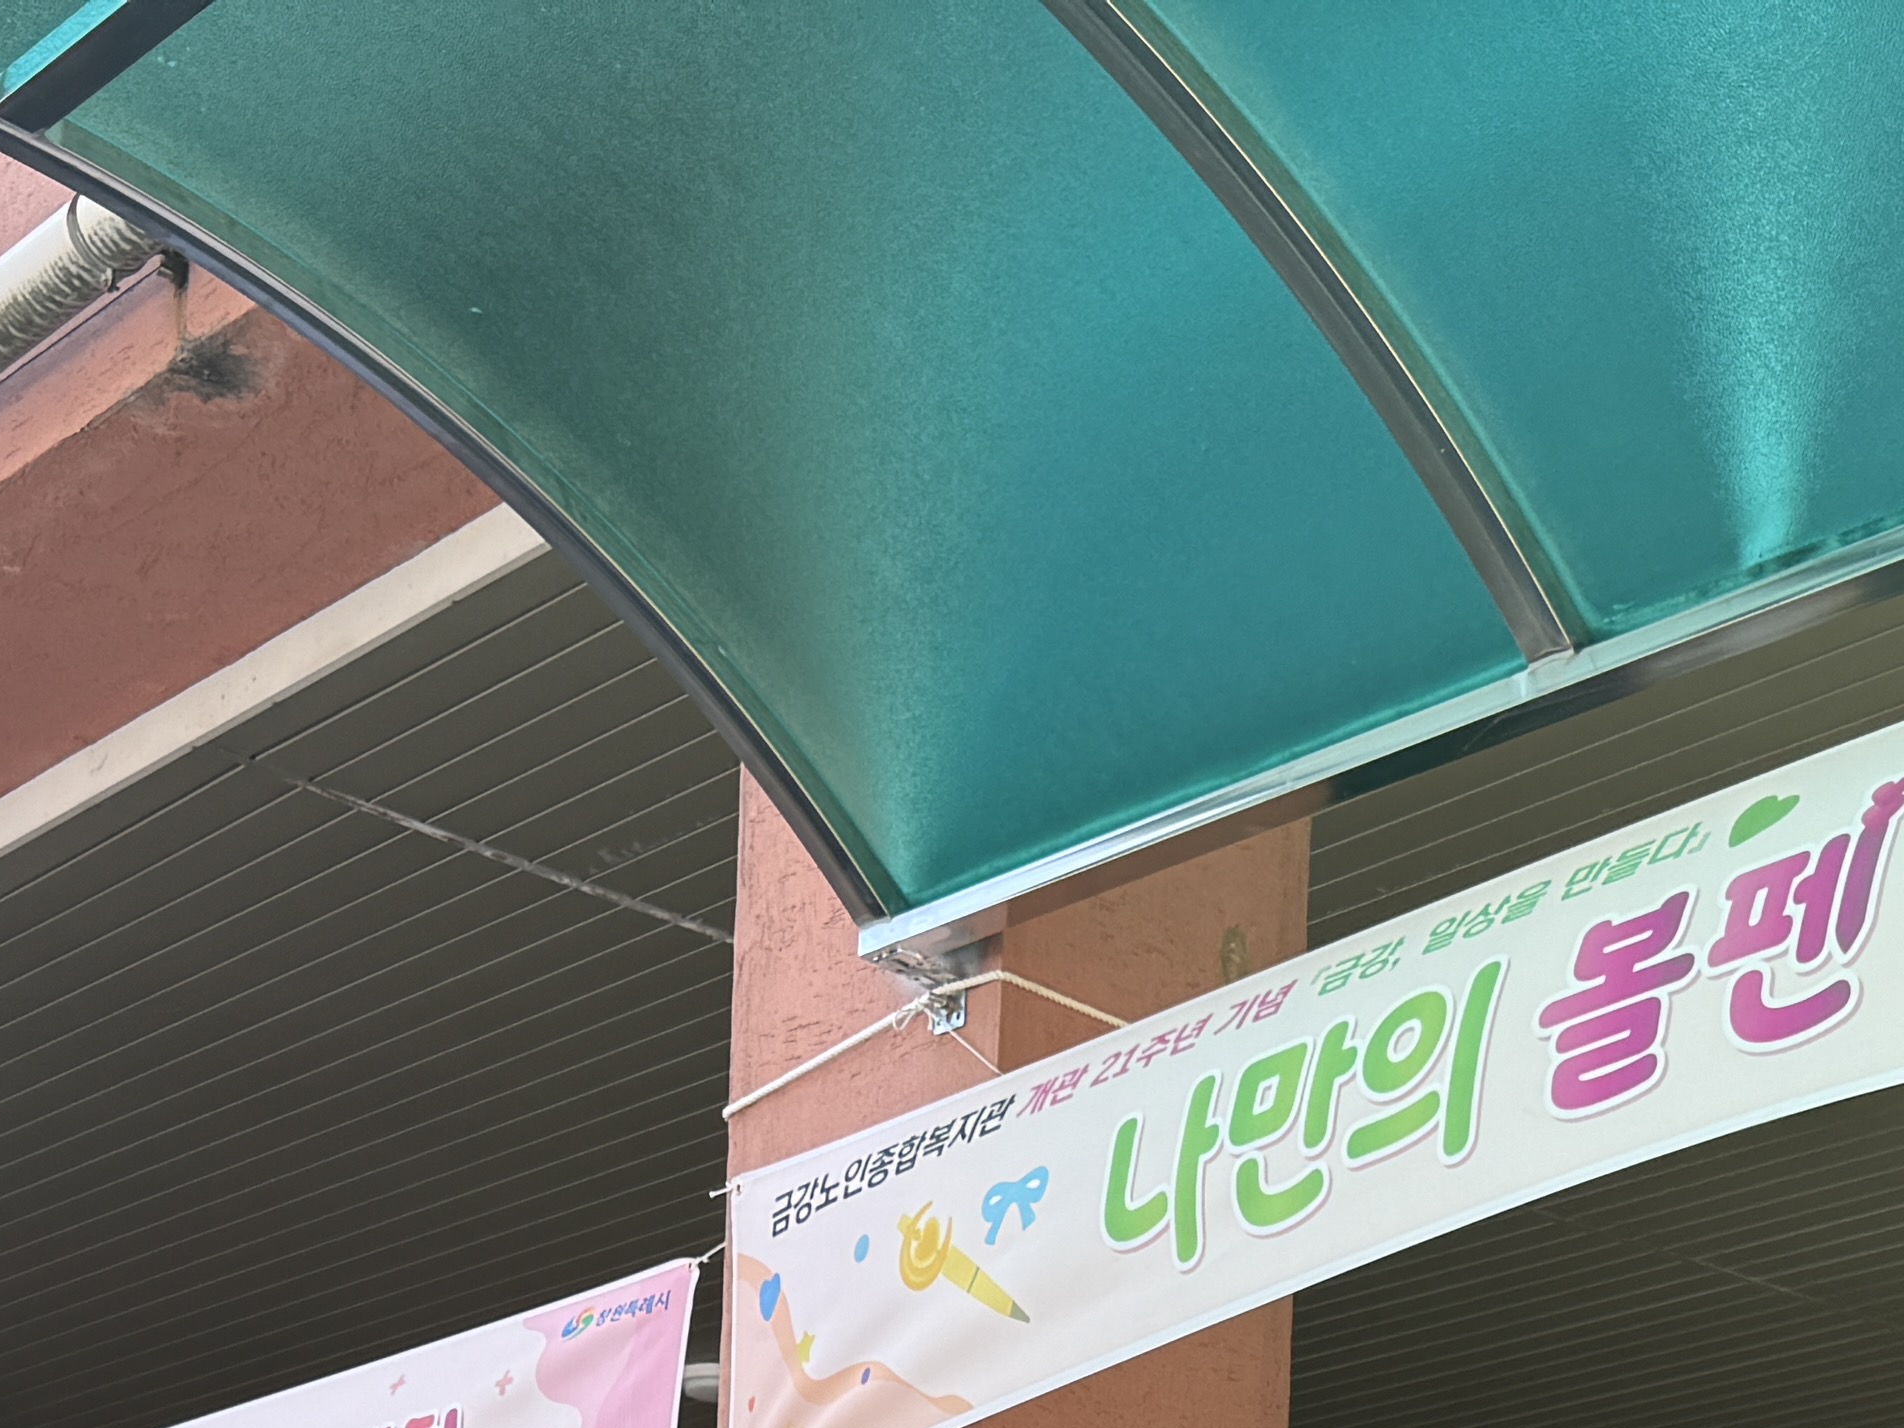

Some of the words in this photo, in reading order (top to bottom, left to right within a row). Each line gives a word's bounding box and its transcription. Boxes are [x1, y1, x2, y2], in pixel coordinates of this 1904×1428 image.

[771, 1094, 1018, 1238] 금강노인종합복지관
[1017, 1063, 1090, 1118] 개관
[1090, 1012, 1215, 1088] 21주년
[1215, 977, 1298, 1037] 기념
[1422, 879, 1553, 956] 일상을
[1101, 959, 1509, 1267] 나만의
